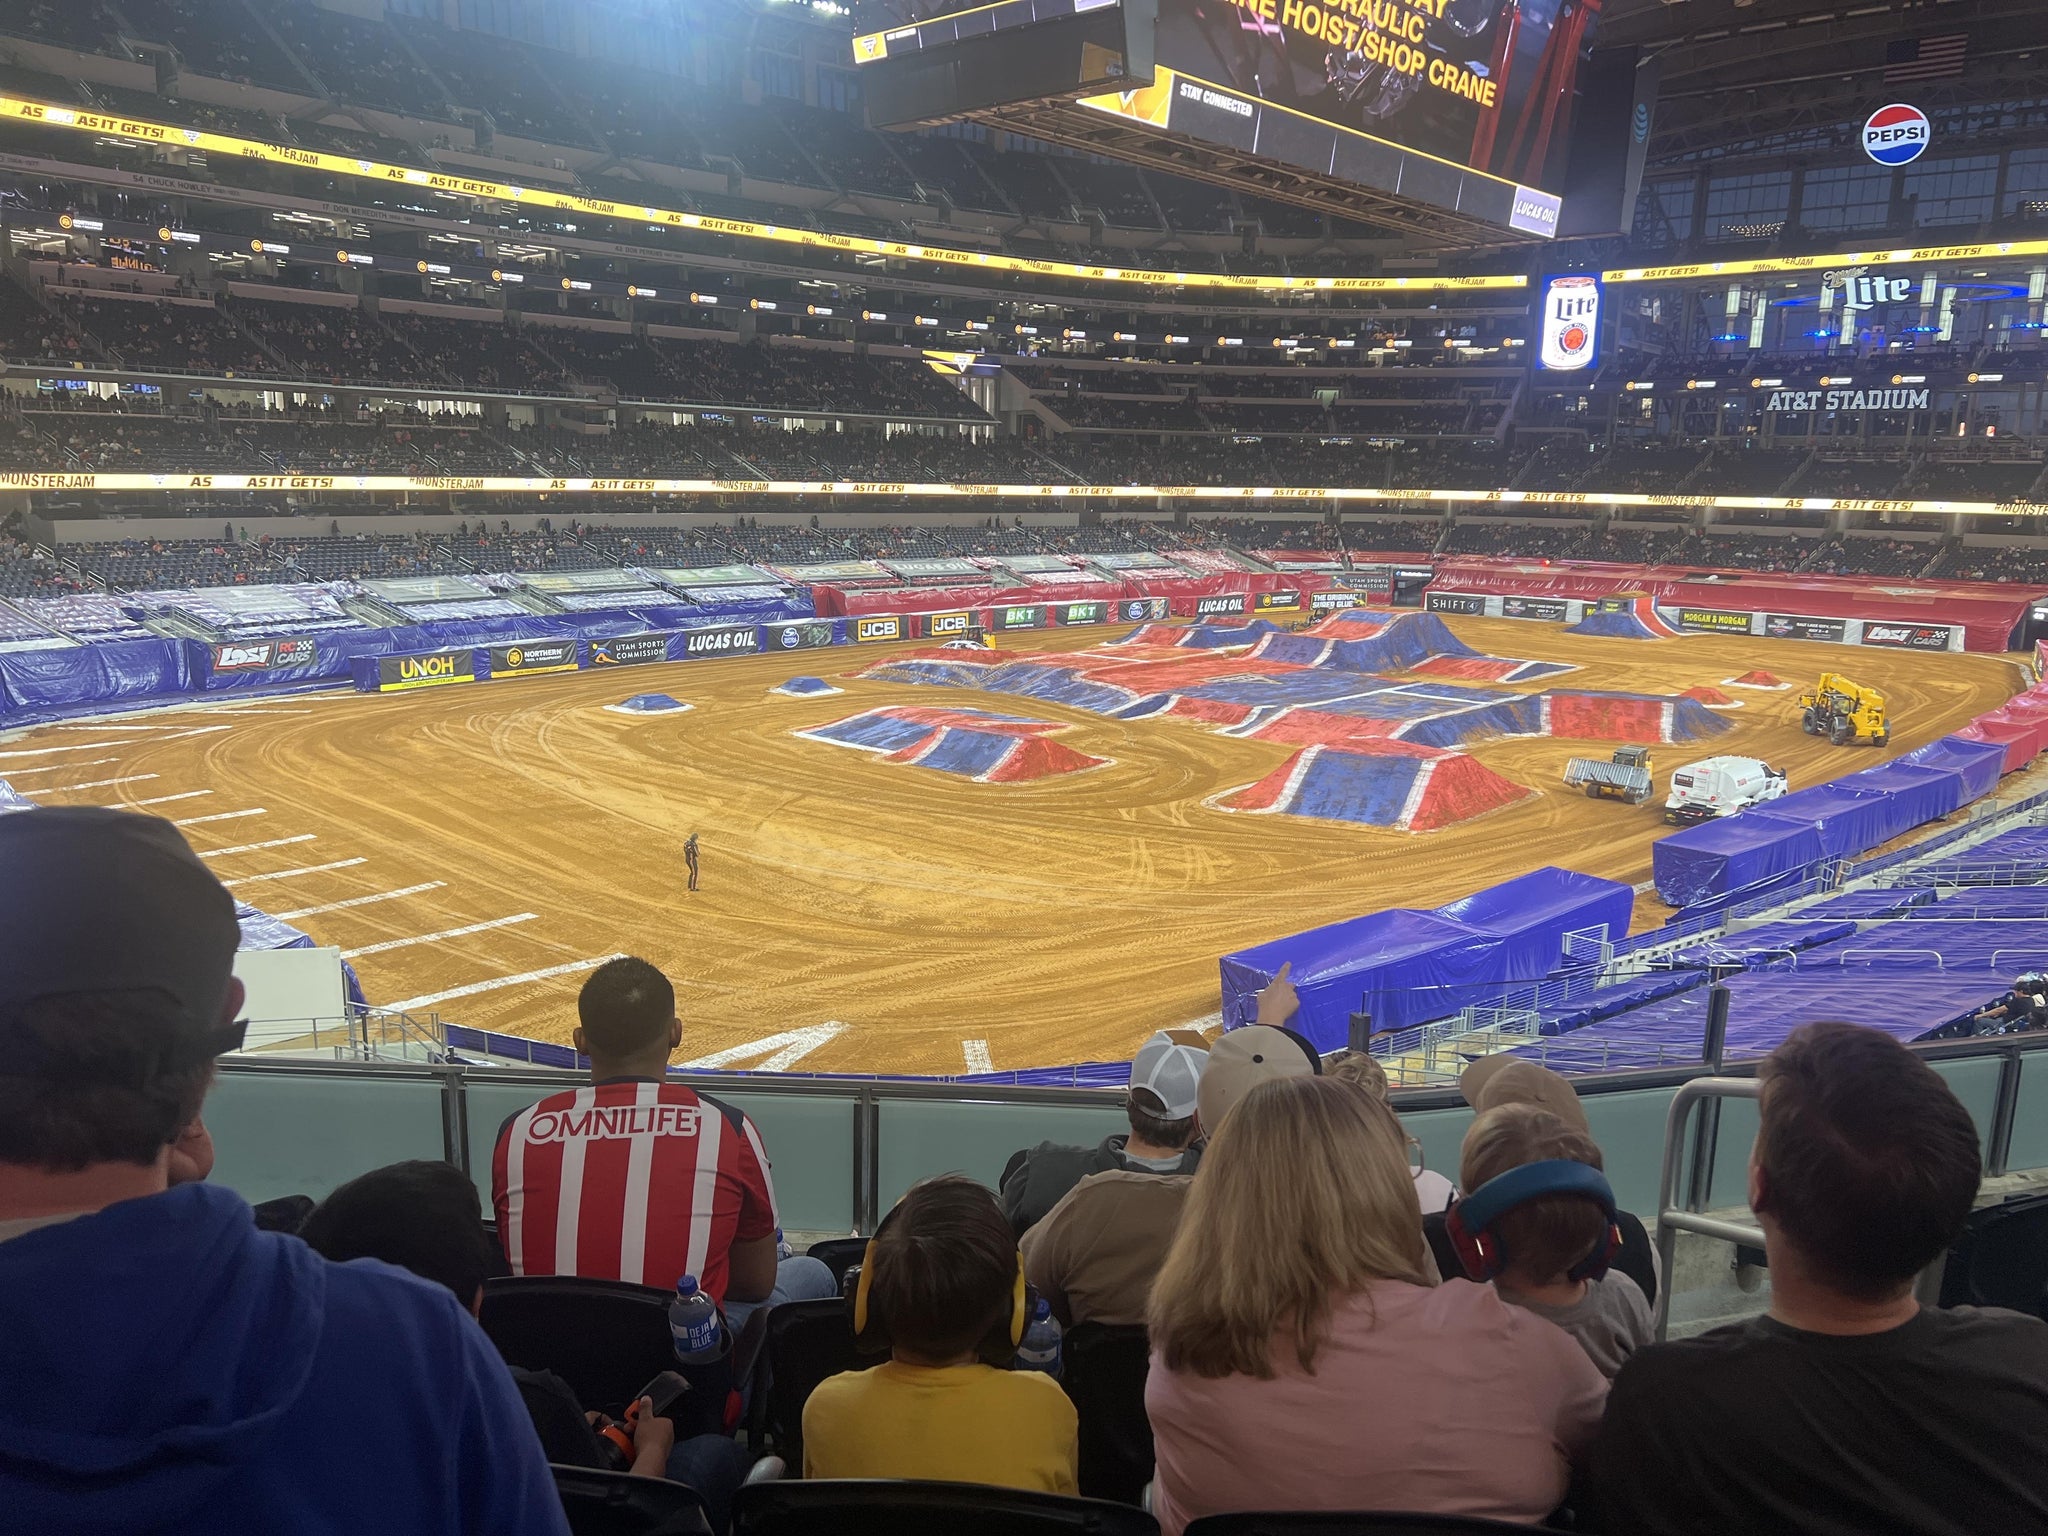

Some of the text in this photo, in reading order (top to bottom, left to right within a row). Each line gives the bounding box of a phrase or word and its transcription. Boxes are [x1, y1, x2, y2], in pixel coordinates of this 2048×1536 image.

[1428, 58, 1497, 108] CRANE
[1180, 82, 1253, 117] STAY CONNECTED
[20, 105, 43, 118] AS
[77, 115, 98, 127] AS
[101, 119, 118, 130] IT
[120, 122, 165, 139] GETS!
[1867, 126, 1925, 144] PEPSI
[148, 177, 176, 188] CHUCK
[178, 181, 211, 193] HOWLEY
[387, 169, 404, 179] AS
[430, 176, 445, 186] AS
[448, 179, 460, 188] IT
[1516, 200, 1555, 223] LUCAS OIL
[667, 214, 681, 223] AS
[700, 219, 715, 228] AS
[715, 221, 725, 229] IT
[895, 246, 906, 254] AS
[923, 249, 934, 257] AS
[1872, 253, 1889, 261] AS
[1930, 249, 1944, 257] IT
[1946, 247, 1981, 256] GETS!
[1092, 269, 1103, 277] AS
[1120, 271, 1131, 279] AS
[1610, 272, 1623, 280] AS
[1657, 268, 1668, 276] IT
[1670, 267, 1699, 275] GETS!
[1843, 276, 1911, 311] Lite
[1555, 297, 1595, 322] Lite
[1766, 388, 1930, 411] AT&T STADIUM
[190, 477, 333, 488] AS AS IT GETS!
[550, 480, 654, 490] AS AS IT GETS!
[853, 484, 865, 492] AS
[867, 484, 877, 492] IT
[1524, 493, 1538, 501] AS
[1540, 493, 1552, 501] IT
[1785, 499, 1913, 510] AS AS IT GETS!
[1198, 598, 1243, 613] LUCAS OIL
[1336, 600, 1353, 608] GLUE
[1432, 598, 1465, 609] SHIFT
[1007, 608, 1034, 621] BKT
[1069, 605, 1096, 618] BKT
[934, 617, 966, 632] JCB
[1684, 613, 1711, 622] MORGAN
[1712, 615, 1717, 623] &
[1718, 615, 1747, 626] MORGAN
[861, 621, 896, 637] JCB
[1917, 628, 1932, 637] RC
[279, 641, 296, 653] RC
[616, 640, 665, 651] UTAH SPORTS
[687, 632, 731, 651] LUCAS
[1913, 636, 1944, 646] CARS
[277, 650, 311, 665] CARS
[524, 648, 562, 658] NORTHERN
[616, 648, 665, 660] COMMISSION
[400, 656, 454, 679] UNOH
[529, 1107, 693, 1139] OMNILIFE
[689, 1322, 710, 1338] DEJA
[691, 1331, 712, 1349] BLUE
